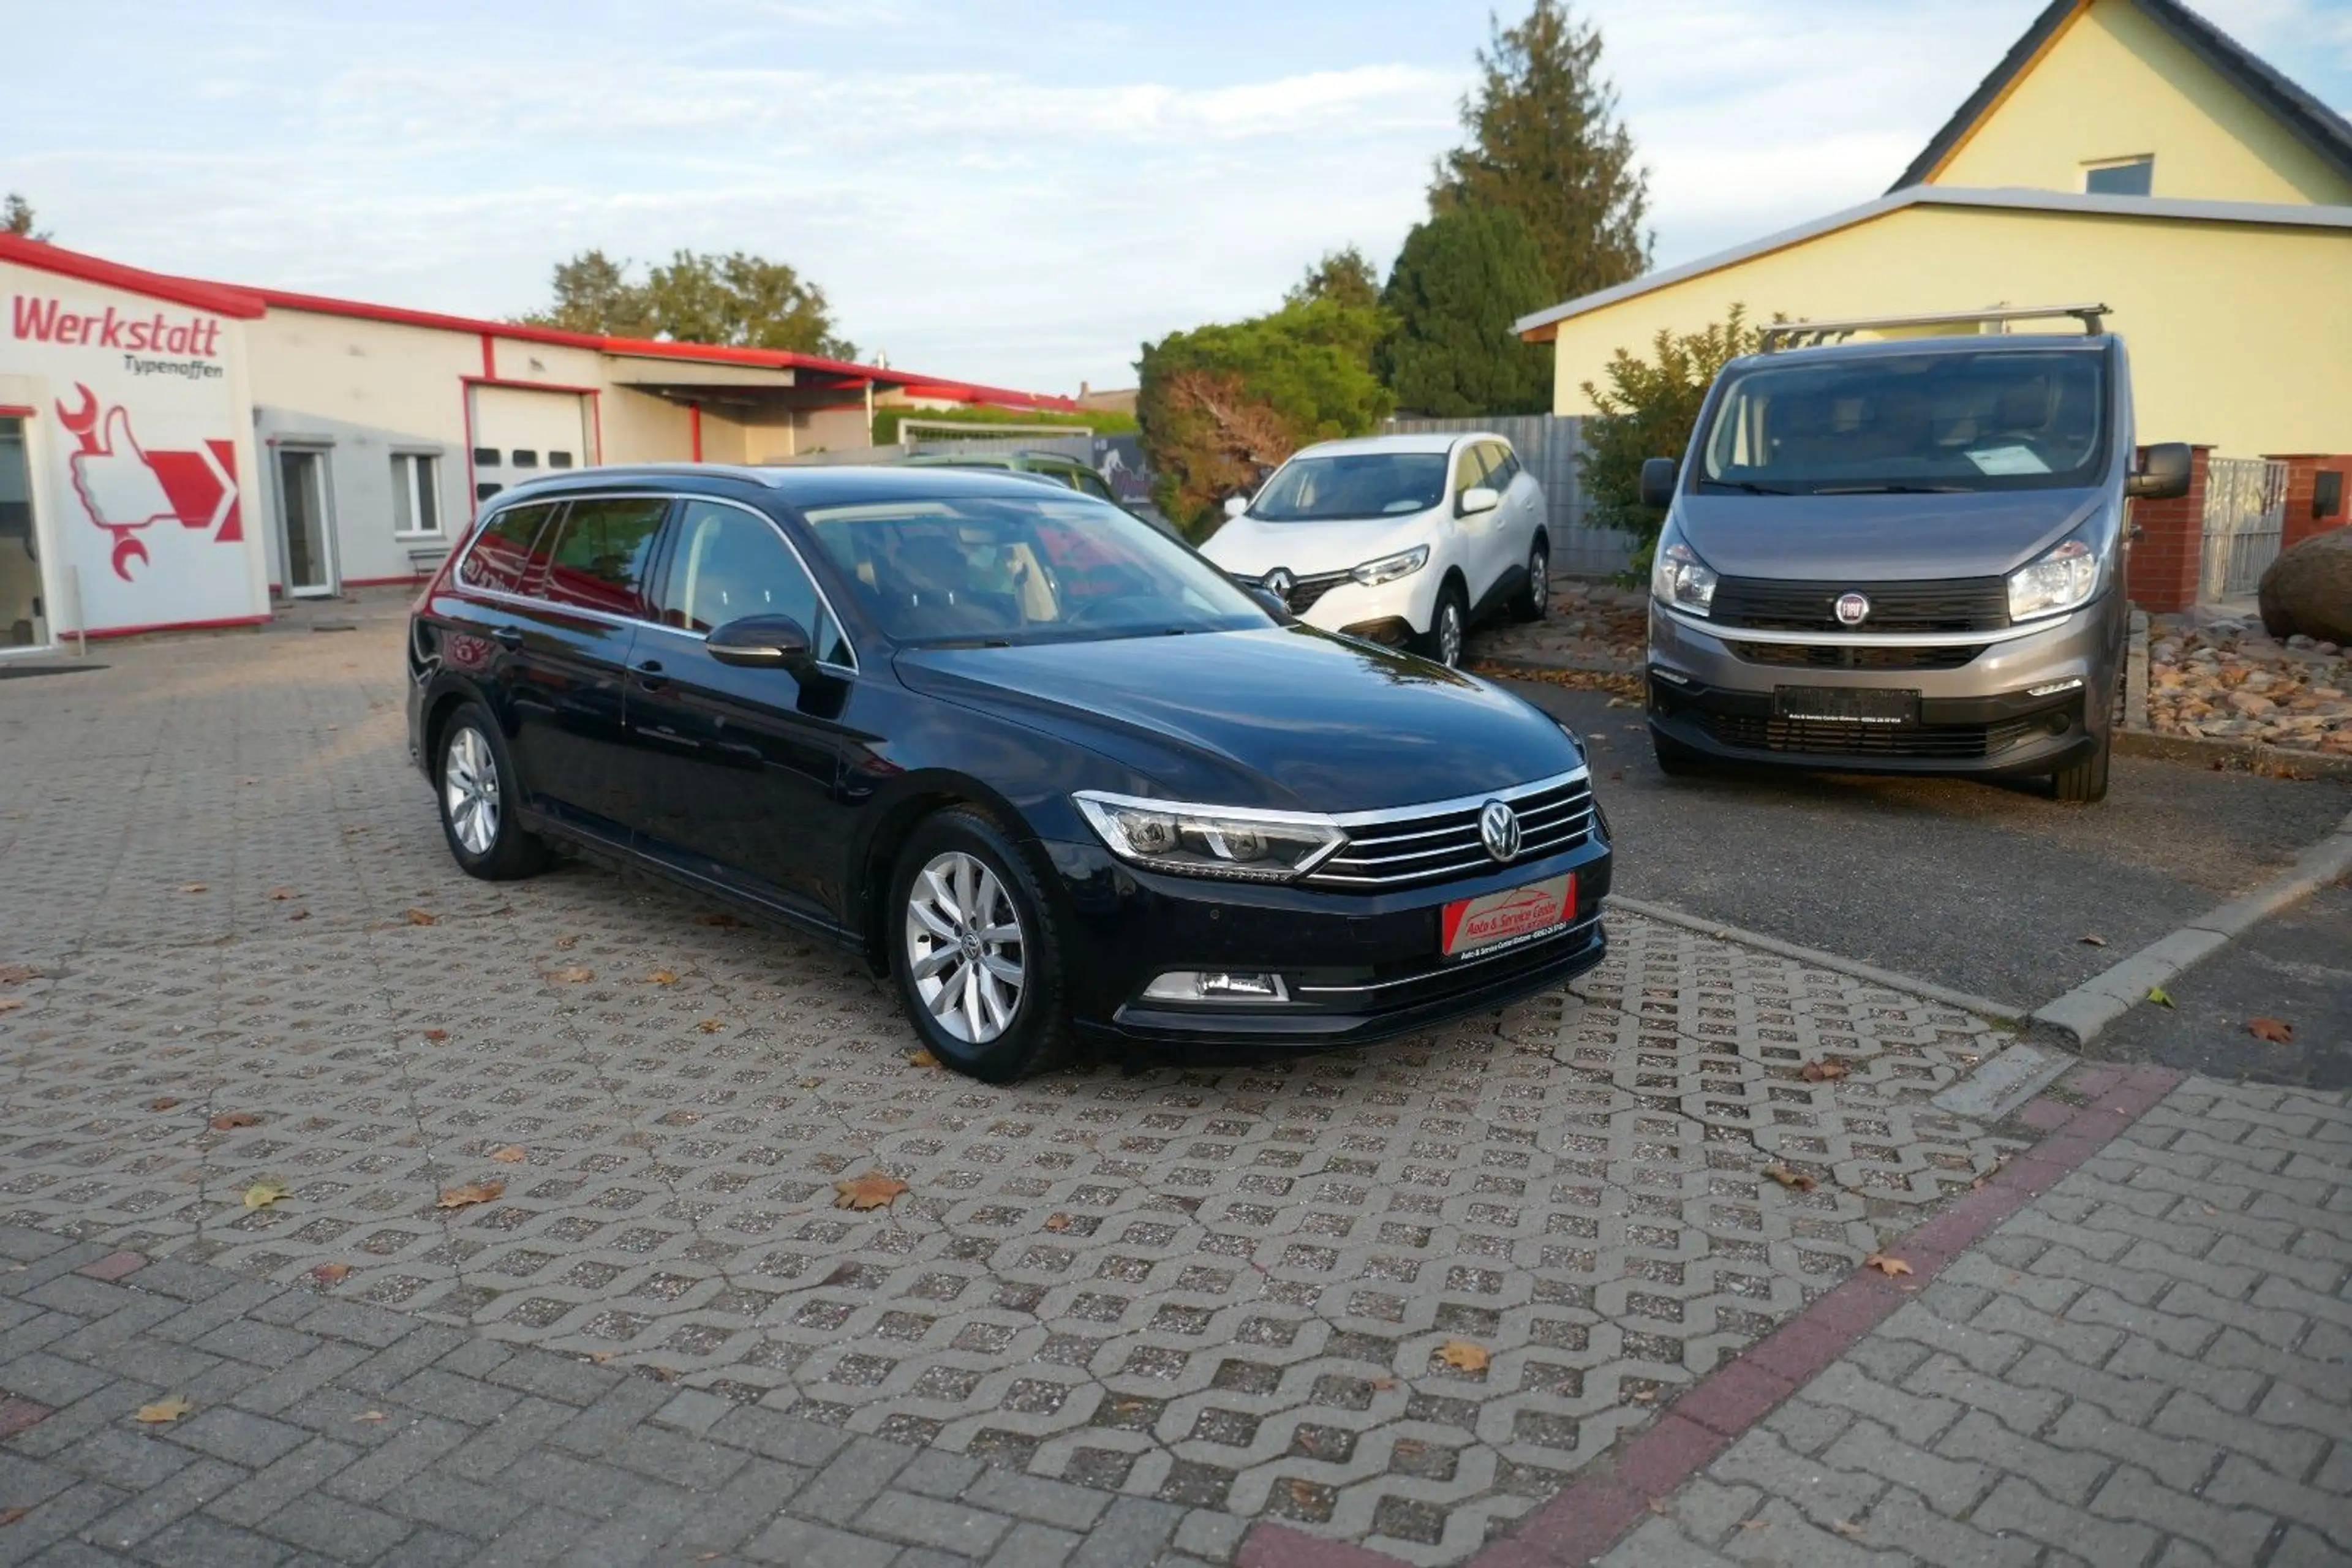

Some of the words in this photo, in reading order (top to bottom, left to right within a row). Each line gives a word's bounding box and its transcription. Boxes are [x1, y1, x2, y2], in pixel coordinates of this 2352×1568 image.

[13, 295, 221, 356] Werkstatt
[123, 355, 224, 380] Typenoffen
[1466, 921, 1489, 935] Auto
[1501, 910, 1531, 927] Service
